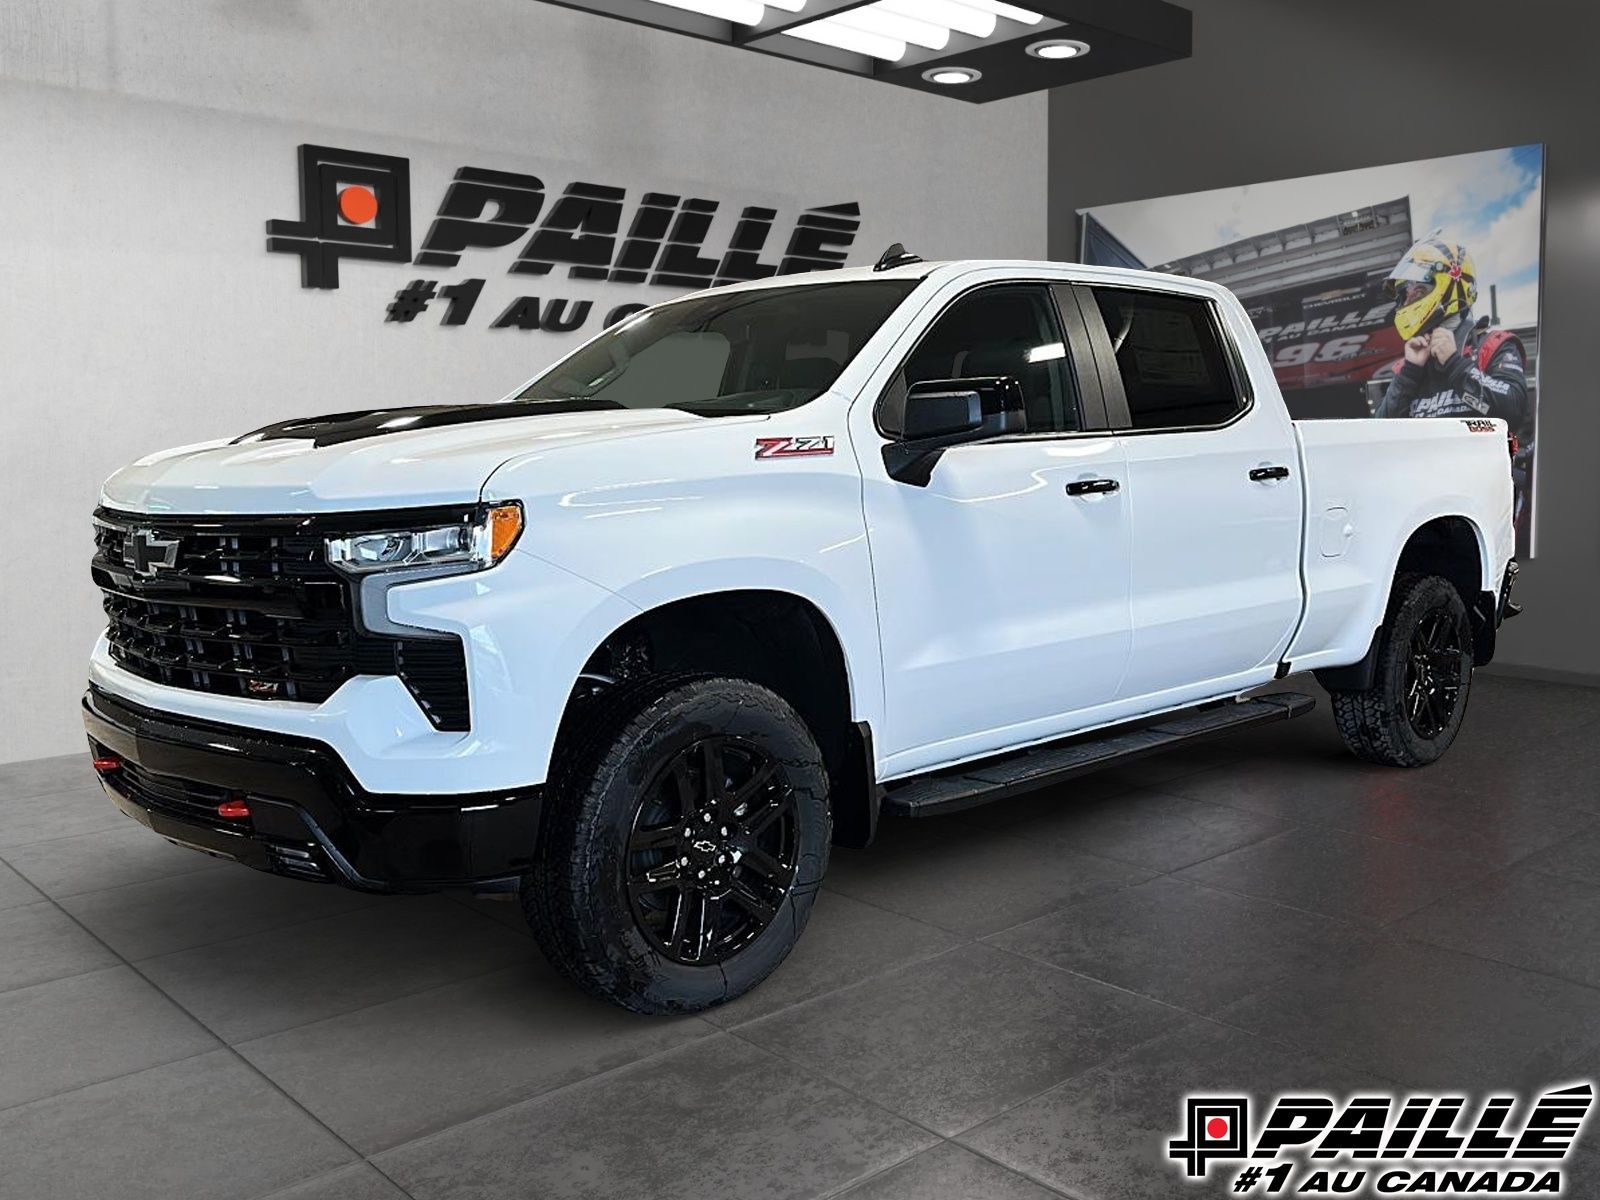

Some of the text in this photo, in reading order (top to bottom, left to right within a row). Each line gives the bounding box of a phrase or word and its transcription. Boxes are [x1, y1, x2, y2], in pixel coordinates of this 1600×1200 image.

[413, 166, 860, 288] PAILLÉ
[384, 278, 486, 326] #1
[489, 296, 594, 332] AU
[1273, 334, 1370, 368] 96
[755, 436, 834, 460] Z71
